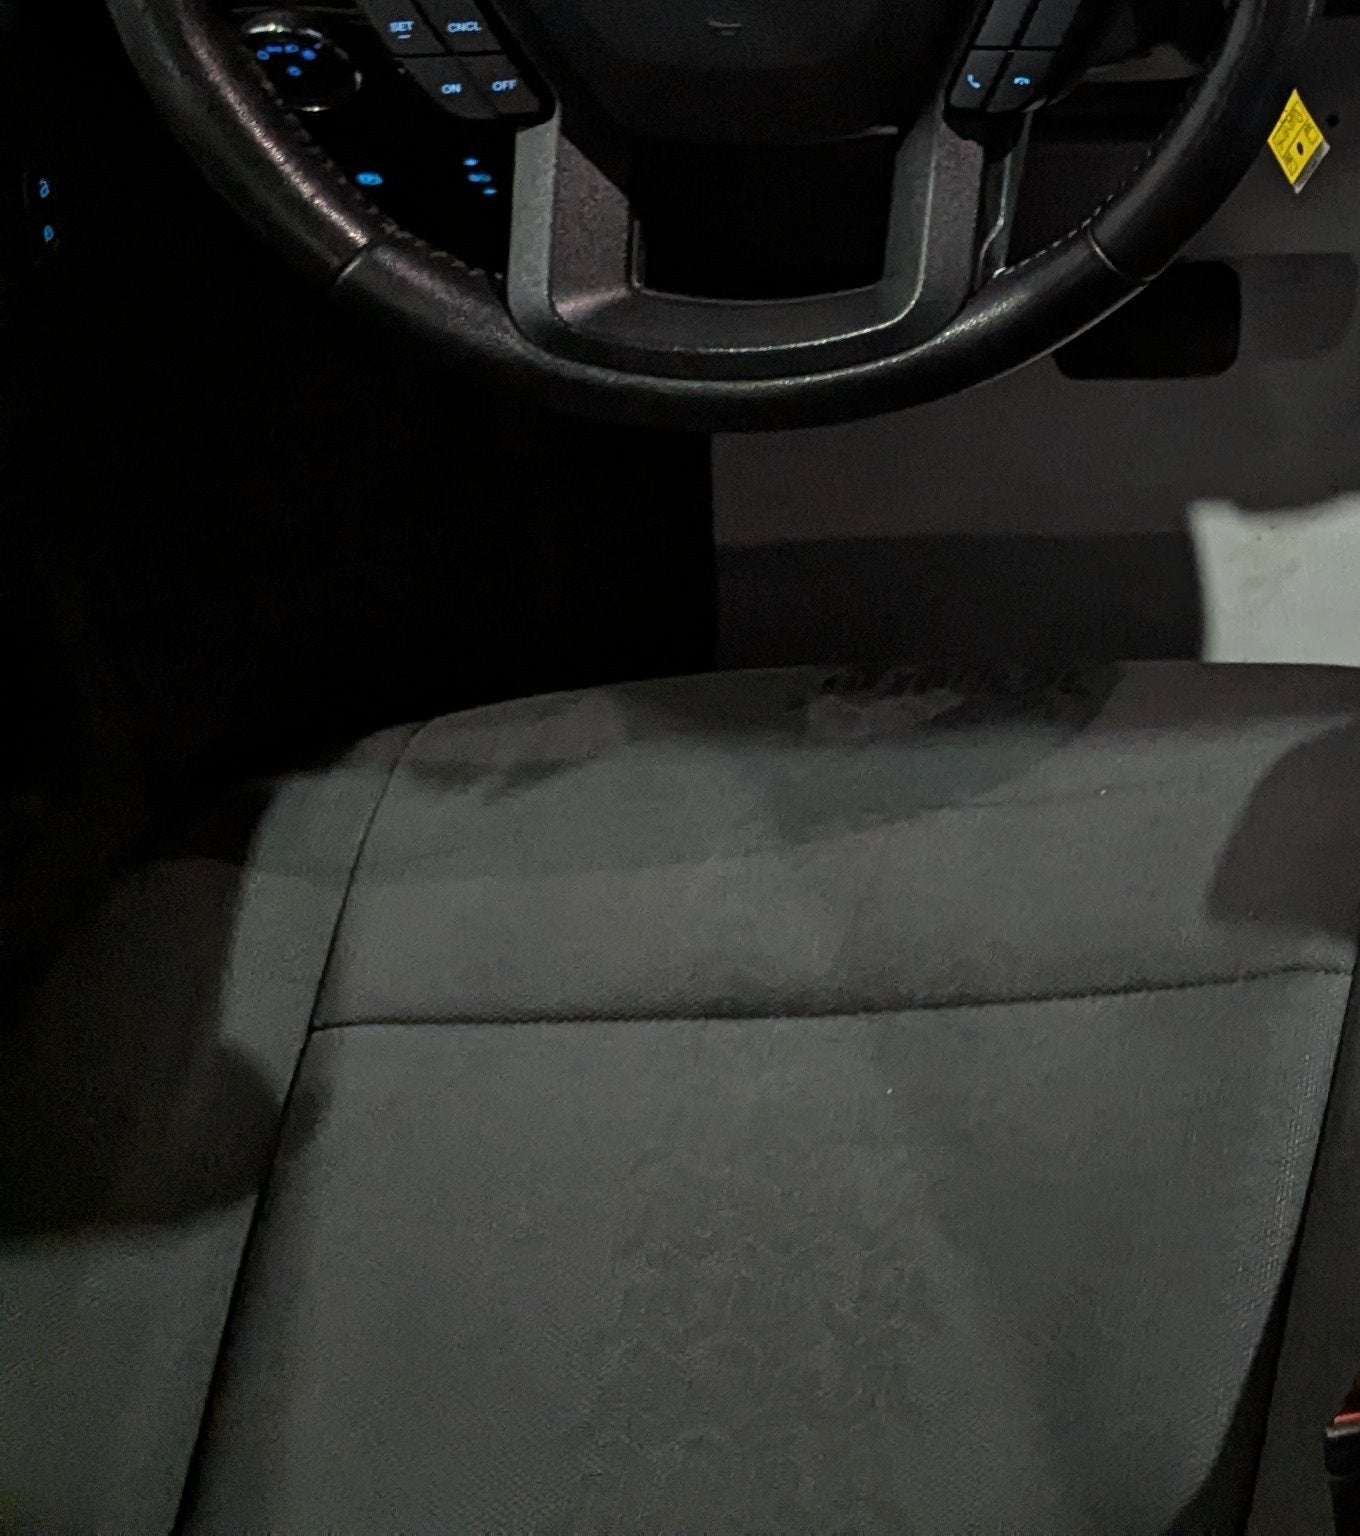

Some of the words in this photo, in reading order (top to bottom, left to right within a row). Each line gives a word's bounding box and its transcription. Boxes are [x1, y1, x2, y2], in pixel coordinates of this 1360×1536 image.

[389, 21, 414, 32] SET
[447, 22, 482, 32] CNCL
[441, 83, 462, 94] ON
[492, 80, 517, 92] OFF
